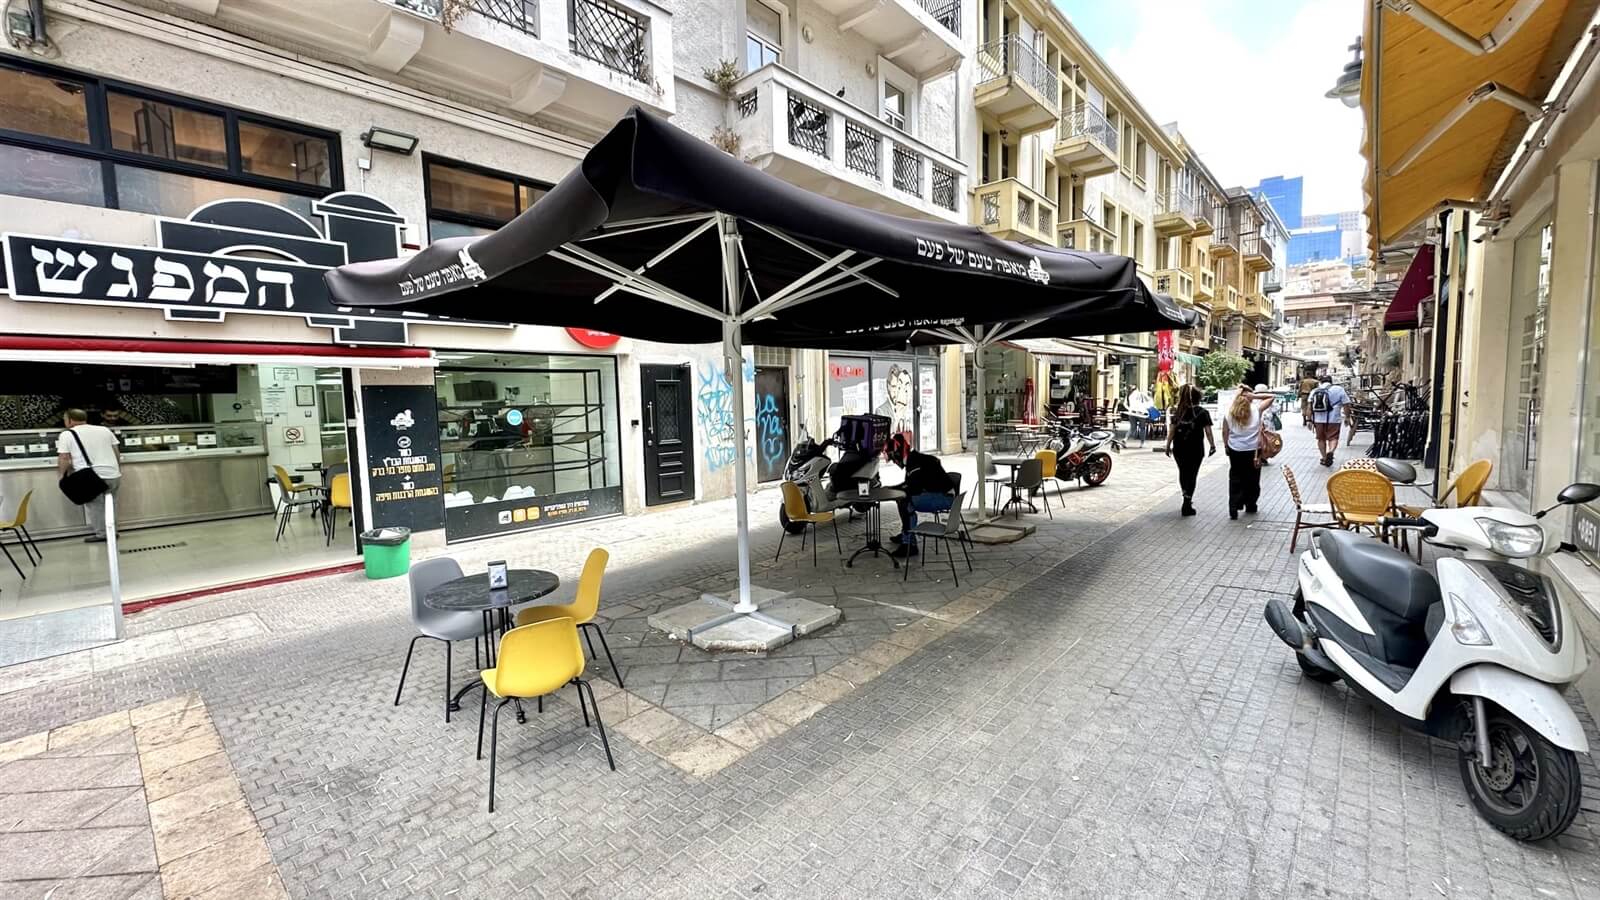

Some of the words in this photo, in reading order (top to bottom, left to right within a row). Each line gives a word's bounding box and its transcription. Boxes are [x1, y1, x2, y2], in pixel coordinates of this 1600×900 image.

[916, 238, 944, 260] פעם
[944, 240, 965, 264] של
[968, 251, 993, 270] טעם
[995, 258, 1027, 276] מאפה
[31, 245, 294, 309] המפגש
[408, 272, 424, 293] של
[424, 271, 441, 290] טעם
[440, 264, 465, 285] מאפה
[398, 281, 414, 296] פעם
